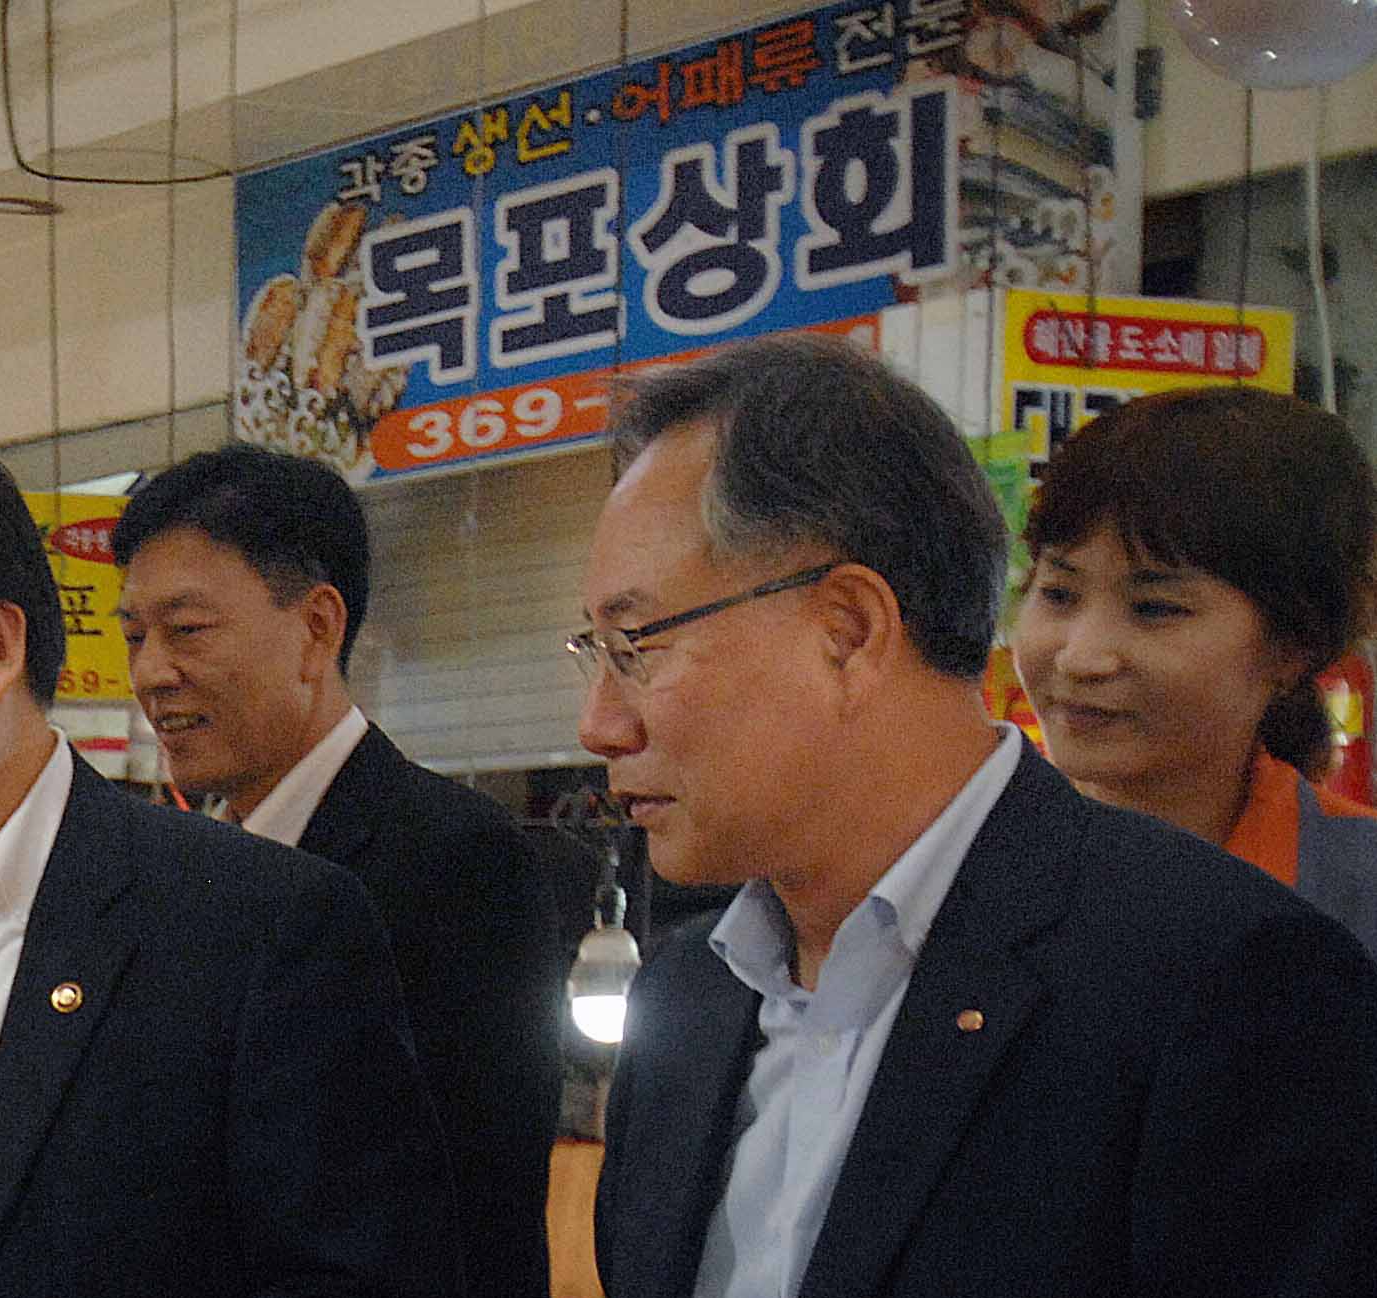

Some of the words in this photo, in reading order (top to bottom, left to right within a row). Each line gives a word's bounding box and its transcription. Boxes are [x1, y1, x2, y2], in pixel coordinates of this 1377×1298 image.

[338, 135, 438, 203] 각종
[359, 78, 960, 386] 목포상회
[406, 388, 607, 460] 369-
